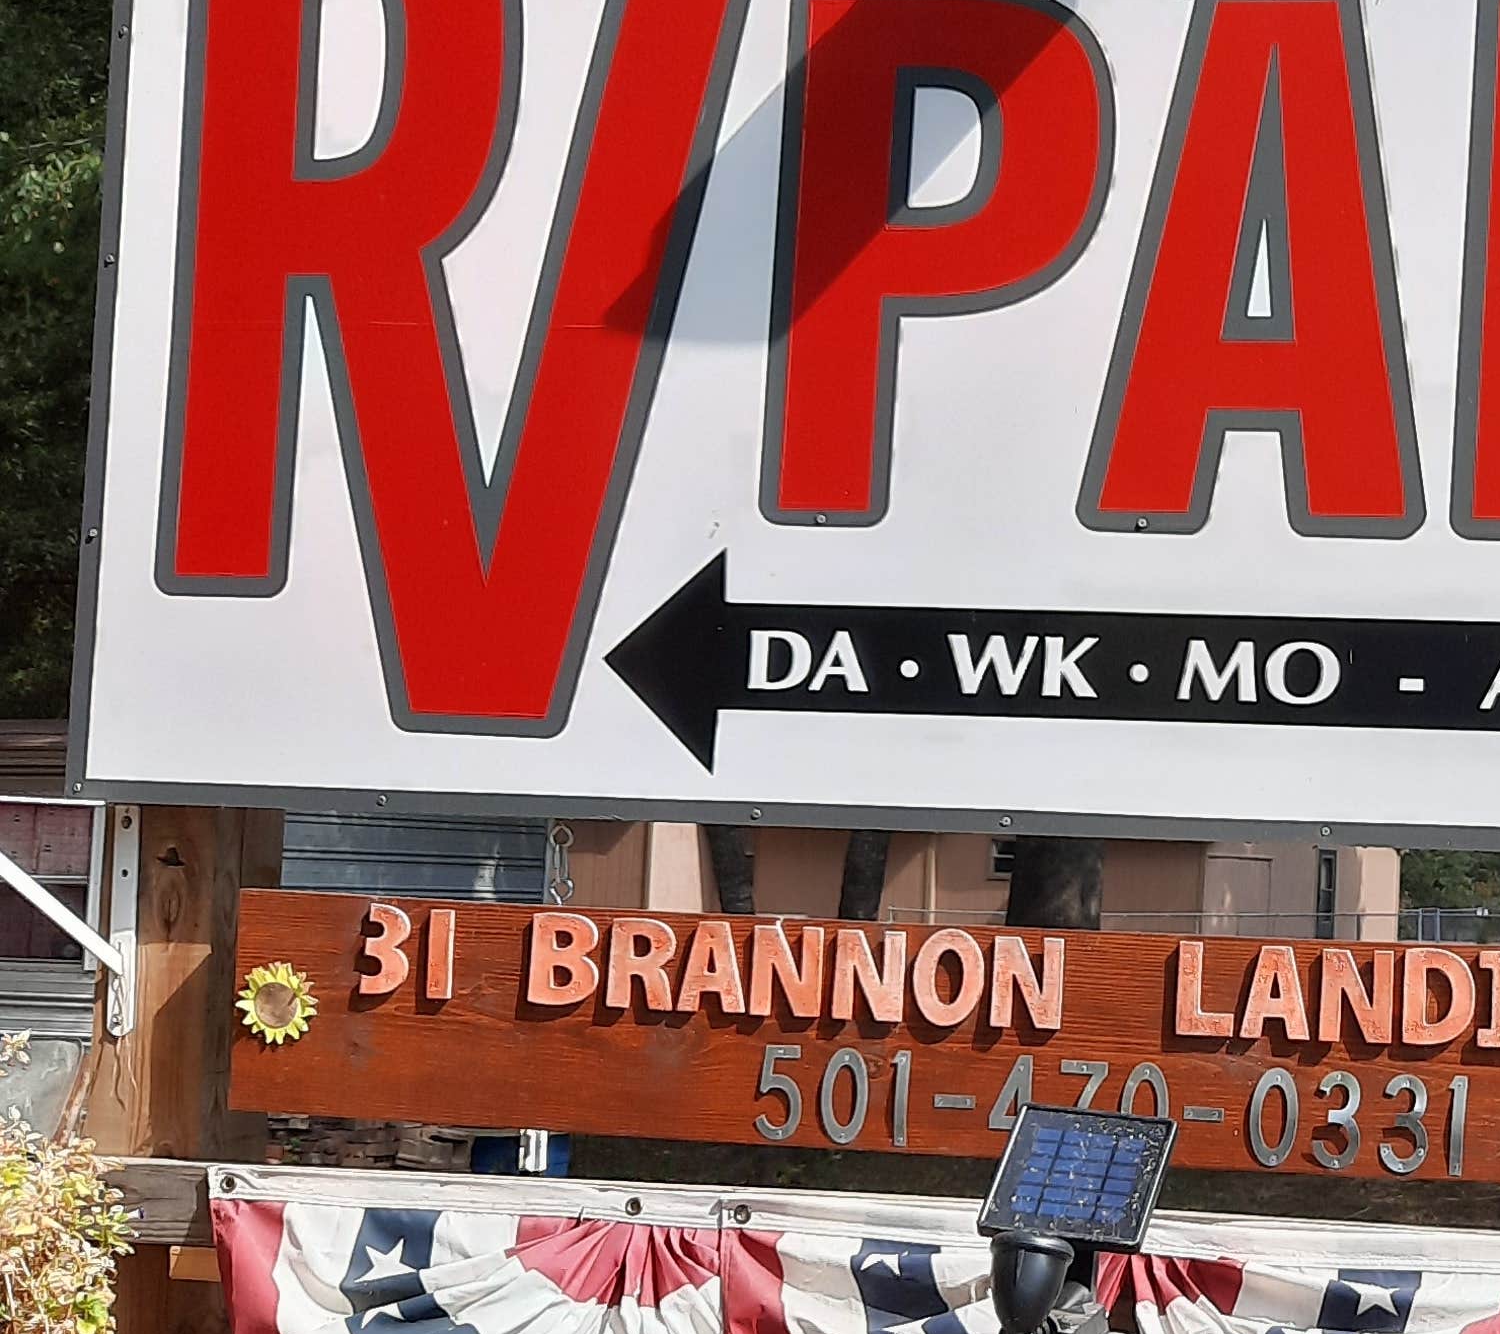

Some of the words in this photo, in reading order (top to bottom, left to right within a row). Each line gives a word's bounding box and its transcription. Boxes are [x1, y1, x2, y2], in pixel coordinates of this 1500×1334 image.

[747, 629, 869, 693] DA
[947, 633, 1099, 699] WK
[1175, 639, 1341, 705] MO
[358, 902, 456, 1000] 31
[525, 911, 1066, 1031] BRANNON
